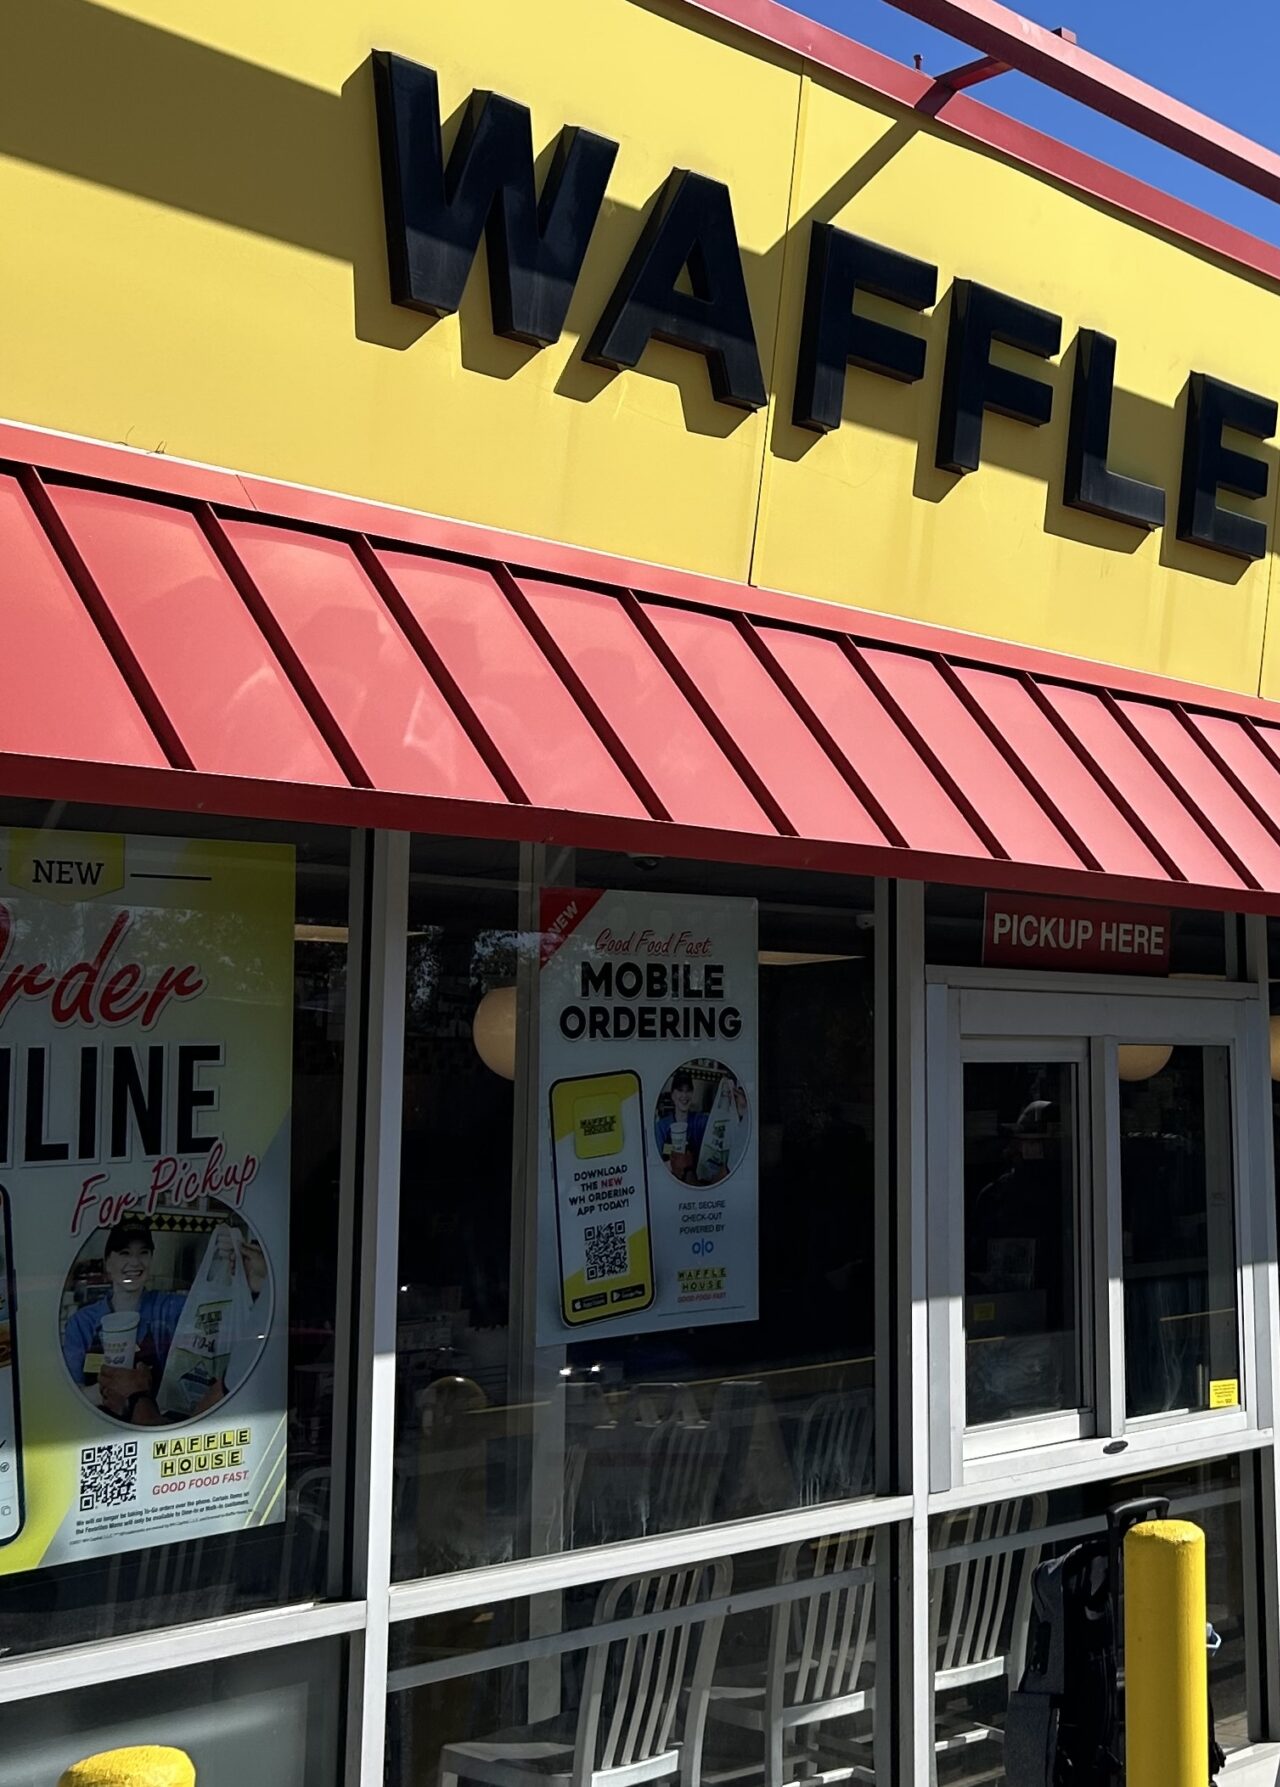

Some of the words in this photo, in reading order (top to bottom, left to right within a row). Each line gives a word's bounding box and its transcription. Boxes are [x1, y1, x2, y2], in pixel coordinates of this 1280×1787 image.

[372, 51, 1277, 561] WAFFLE
[32, 859, 105, 886] NEW
[595, 928, 638, 954] Good
[636, 929, 673, 955] Food
[993, 912, 1093, 950] PICKUP
[1100, 921, 1165, 956] HERE
[0, 904, 204, 1028] rder
[581, 961, 724, 999] MOBILE
[559, 1005, 742, 1039] ORDERING
[0, 1044, 221, 1165] LINE
[574, 1164, 628, 1182] DOWNLOAD
[581, 1180, 598, 1193] THE
[601, 1177, 623, 1190] NEW
[71, 1173, 138, 1234] For
[147, 1143, 257, 1214] Pickup
[569, 1195, 586, 1207] WH
[588, 1187, 636, 1203] ORDERING
[577, 1205, 595, 1217] APP
[598, 1200, 630, 1214] TODAY!
[153, 1429, 250, 1458] WAFFLE
[161, 1451, 243, 1477] HOUSE
[152, 1480, 185, 1496] GOOD
[188, 1475, 219, 1490] FOOD
[222, 1470, 249, 1484] FAST
